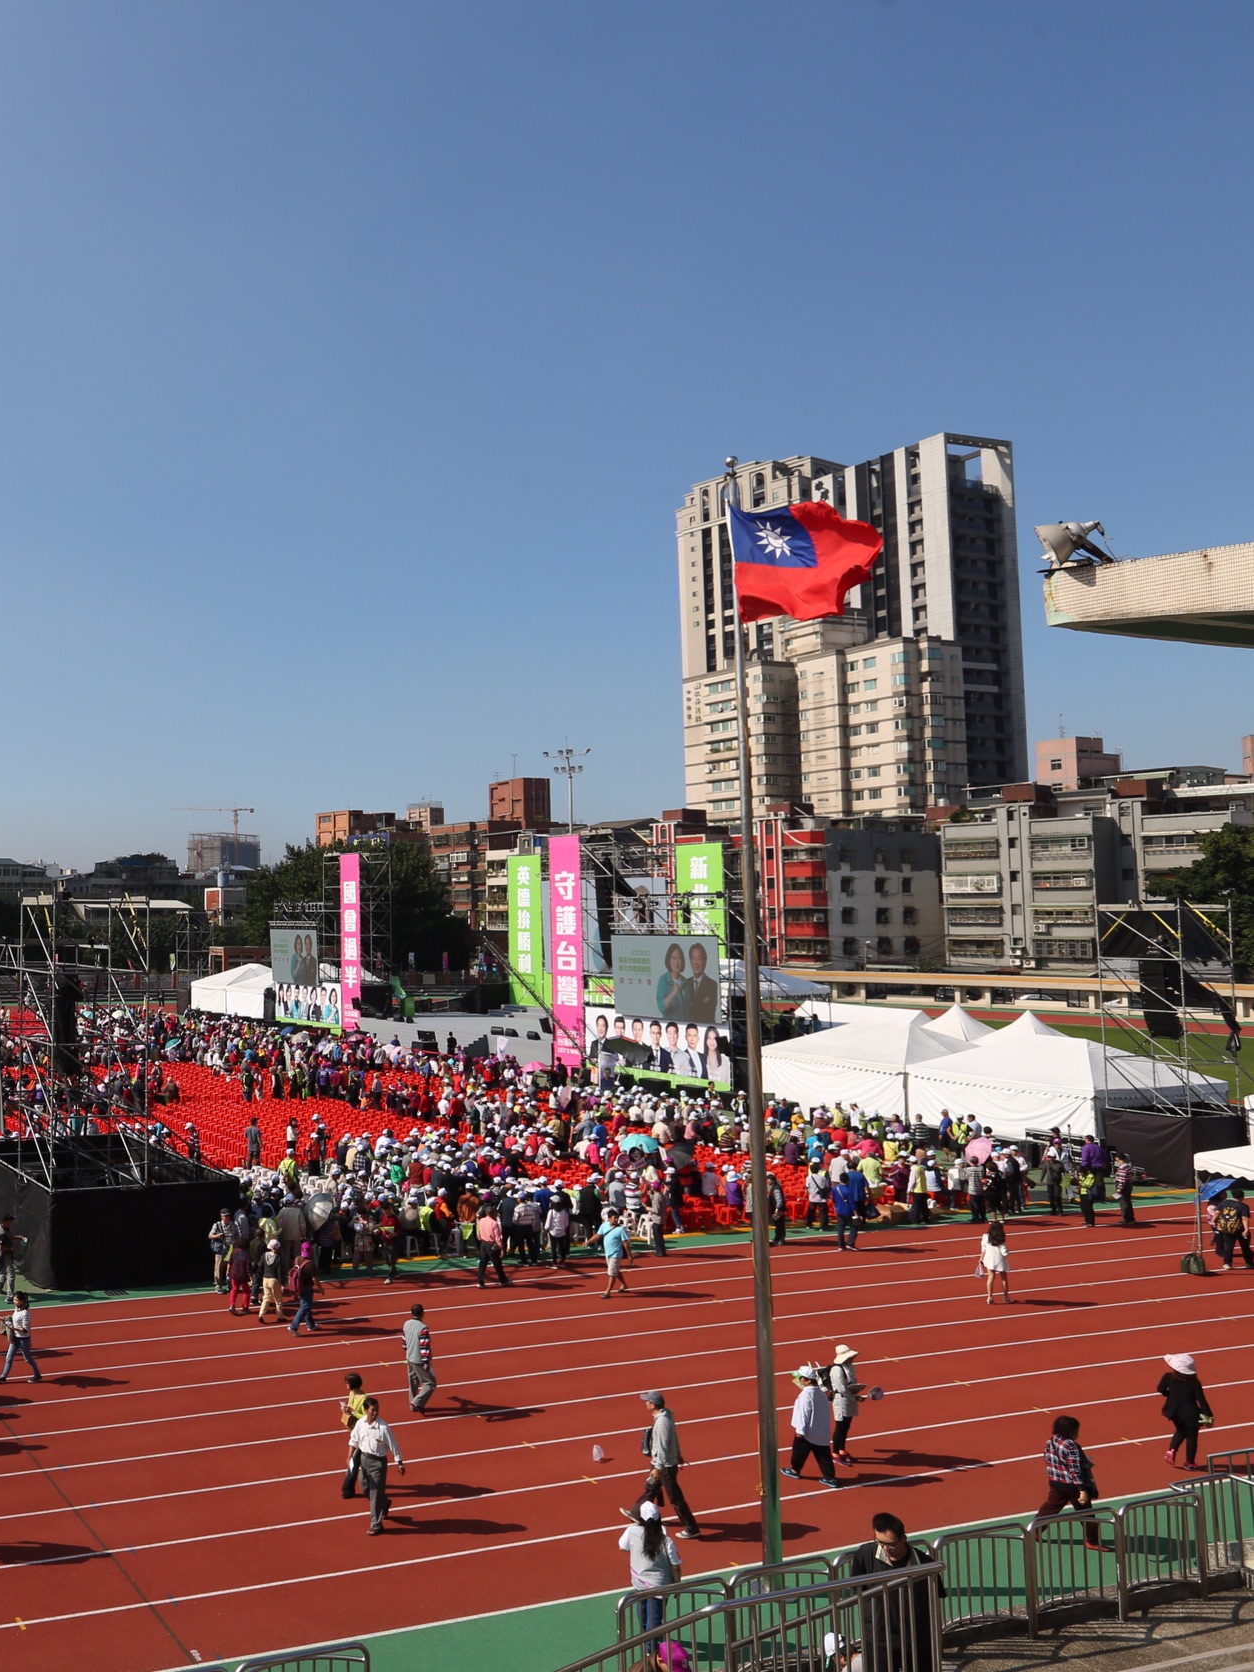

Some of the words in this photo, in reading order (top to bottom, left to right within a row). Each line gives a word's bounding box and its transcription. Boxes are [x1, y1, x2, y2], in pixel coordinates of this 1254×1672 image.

[343, 881, 358, 988] 國會過半
[517, 866, 531, 973] 英德拚勝利
[554, 871, 578, 1006] 守護台灣
